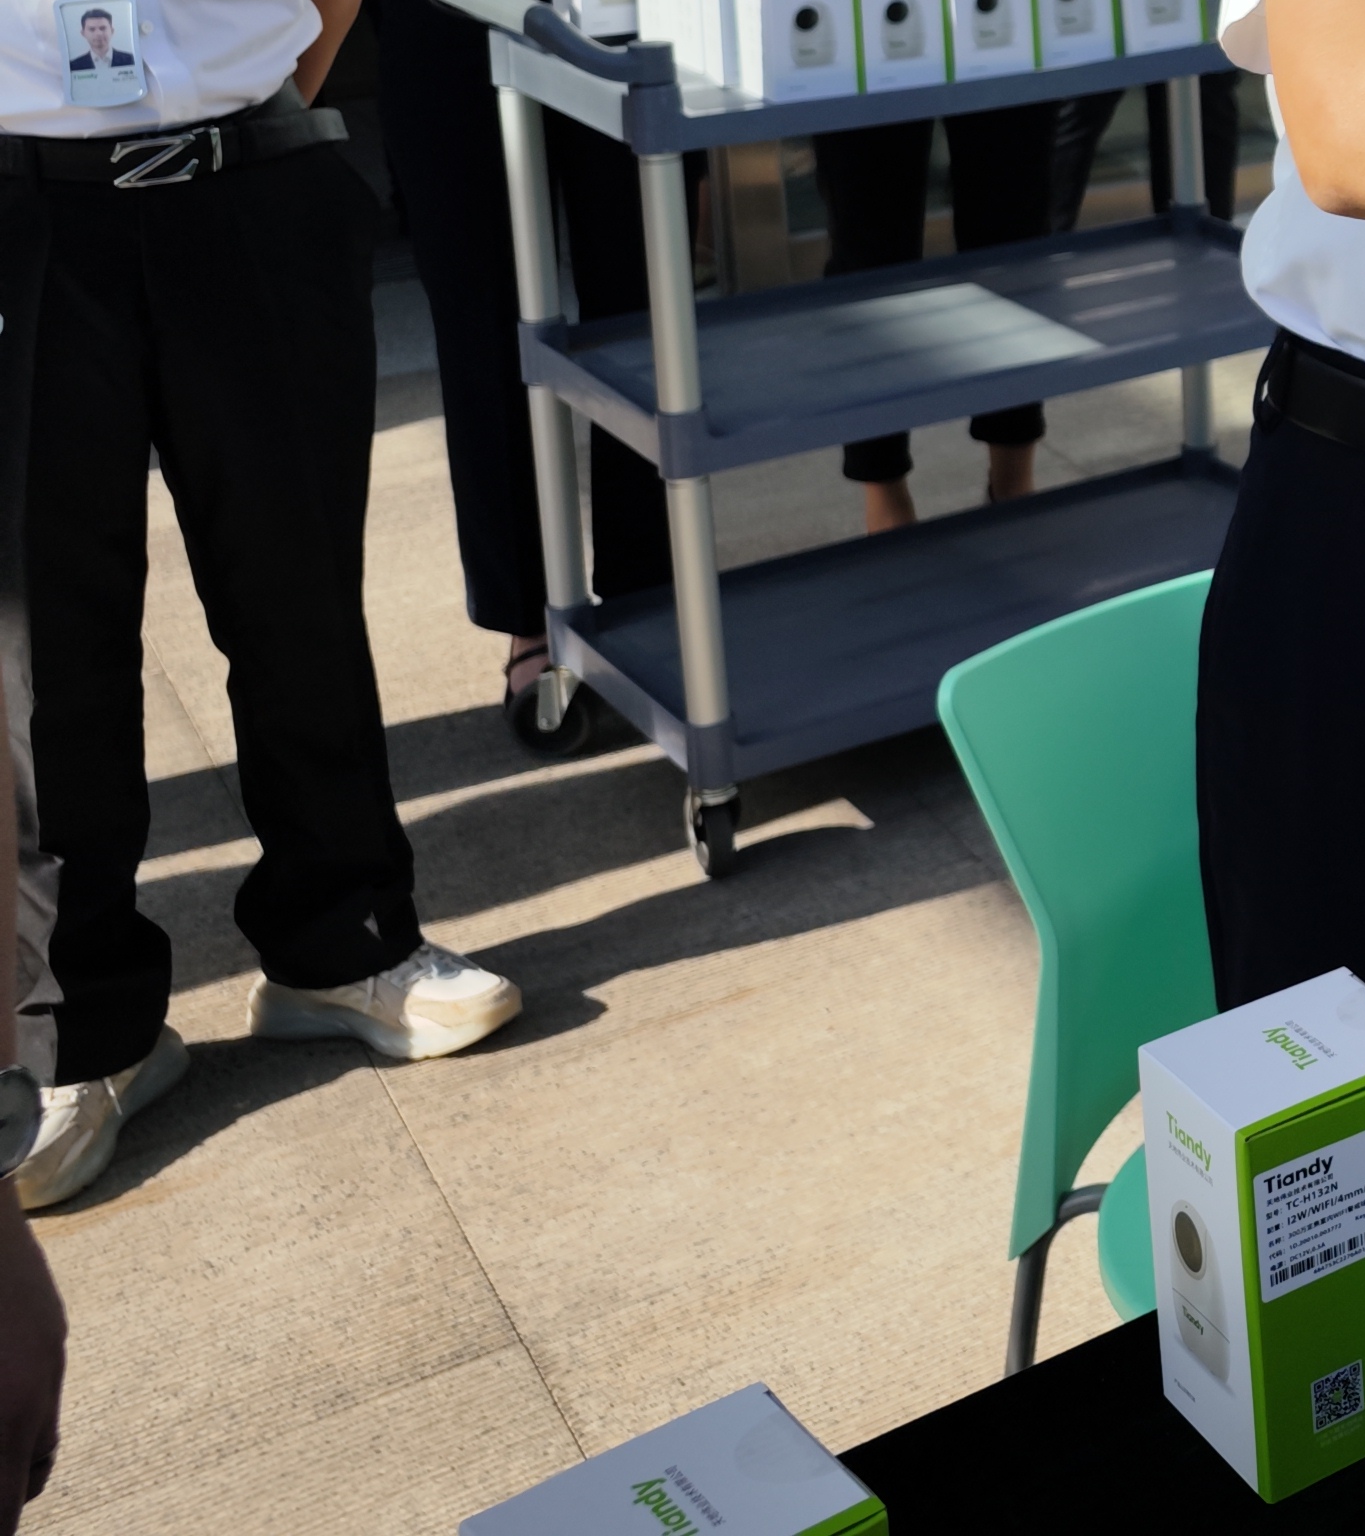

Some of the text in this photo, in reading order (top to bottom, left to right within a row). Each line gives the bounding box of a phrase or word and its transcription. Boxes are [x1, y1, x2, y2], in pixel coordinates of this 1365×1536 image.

[1262, 1027, 1319, 1070] Tiandy
[1166, 1110, 1211, 1172] Tiandy
[1263, 1155, 1334, 1194] Tiandy
[1266, 1173, 1334, 1207] 天地伟业技术有限公司
[1285, 1181, 1339, 1211] TC-H132N
